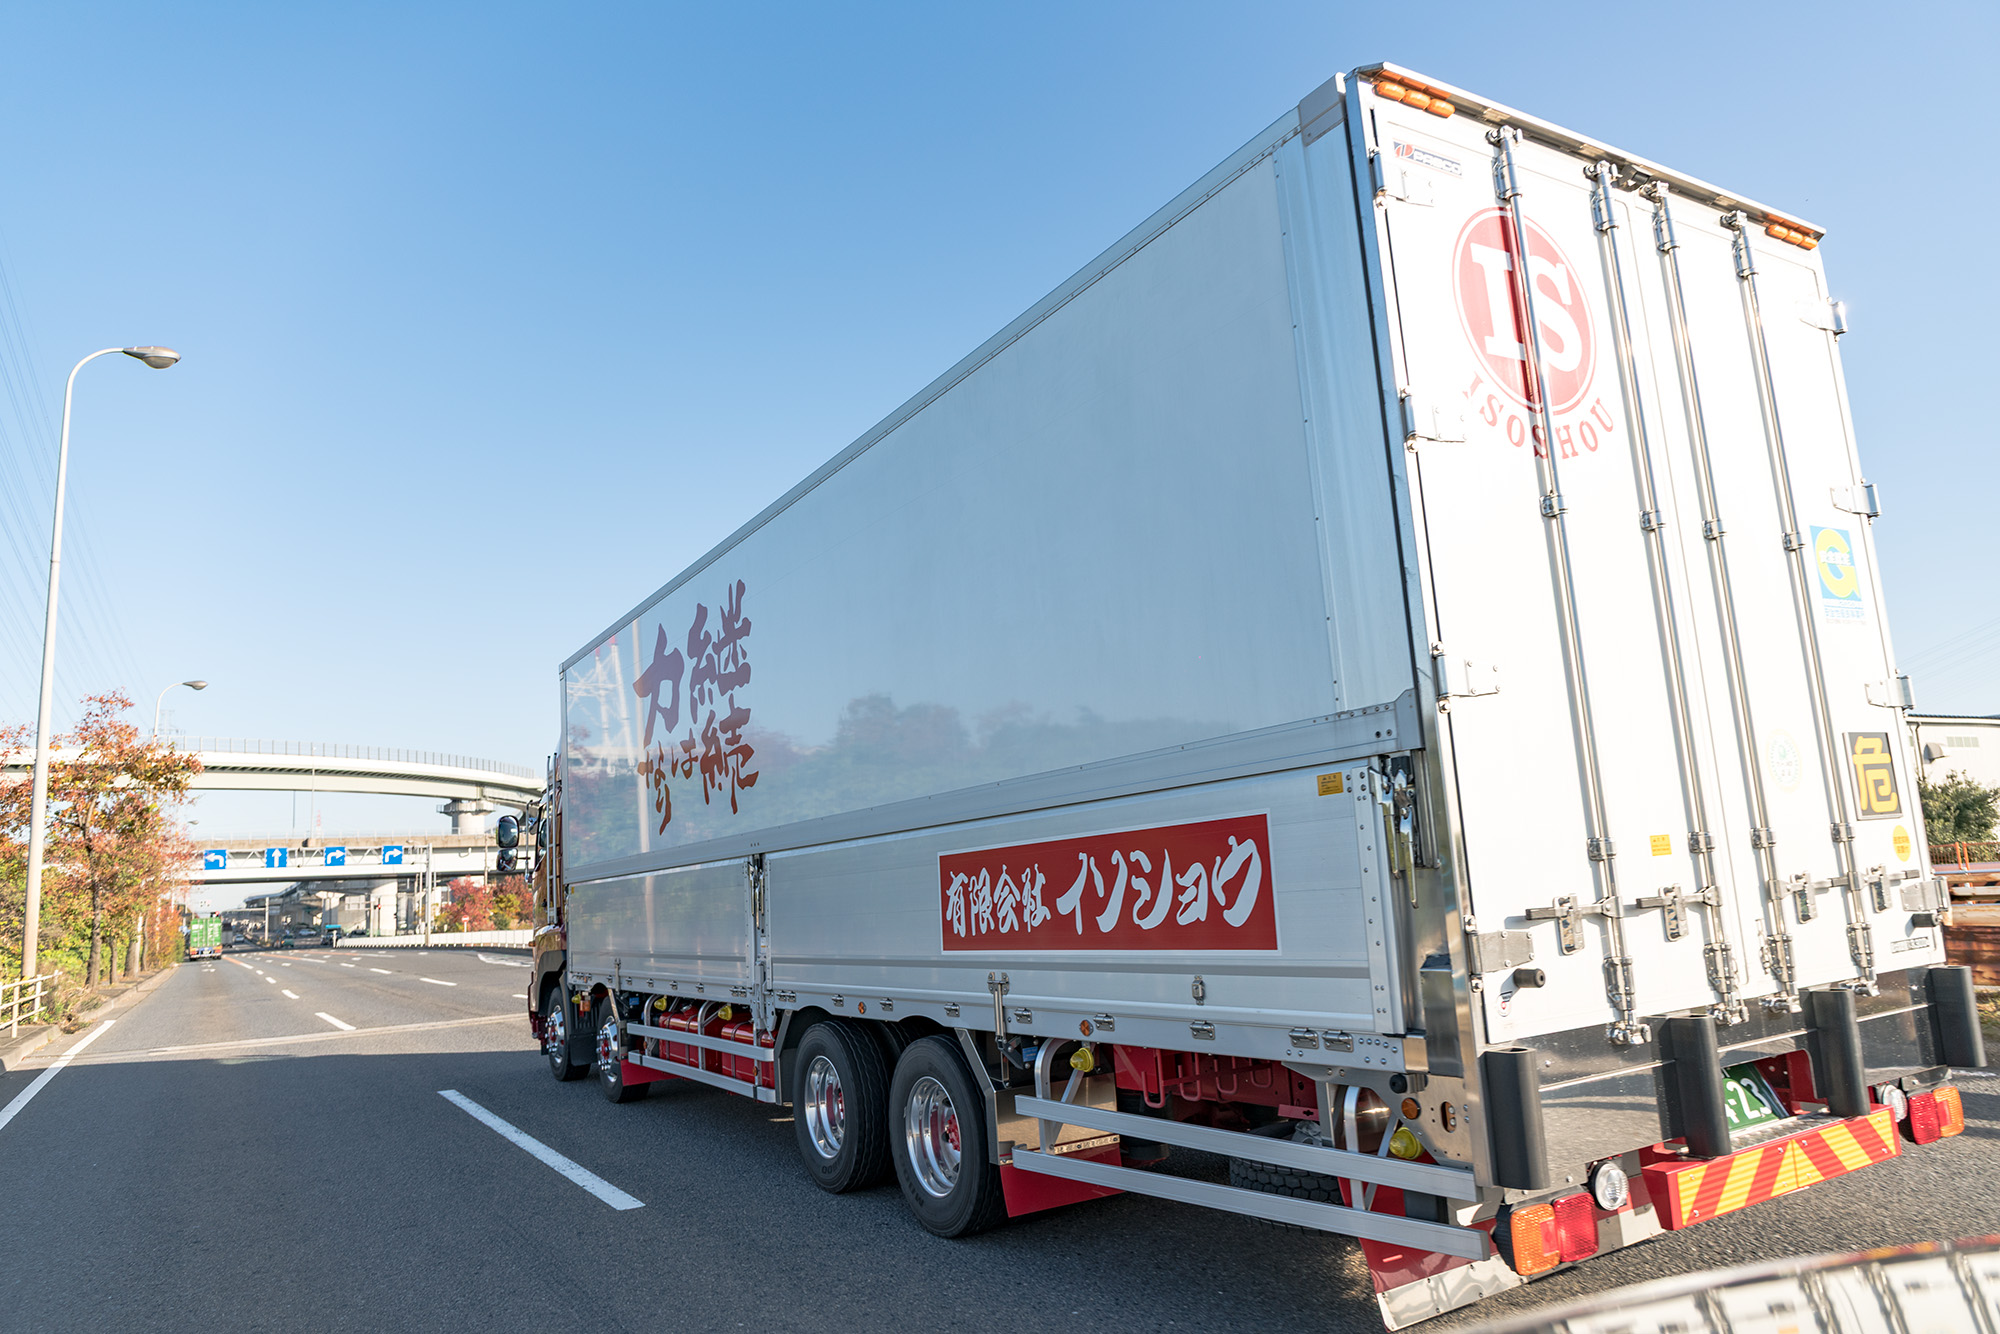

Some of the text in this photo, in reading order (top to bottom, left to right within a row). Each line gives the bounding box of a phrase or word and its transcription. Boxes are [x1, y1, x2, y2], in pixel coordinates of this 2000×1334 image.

[1470, 242, 1583, 373] IS
[1462, 371, 1613, 460] ISOSHOU
[1853, 736, 1898, 813] 危
[945, 835, 1263, 938] 有限会社 イソショウ
